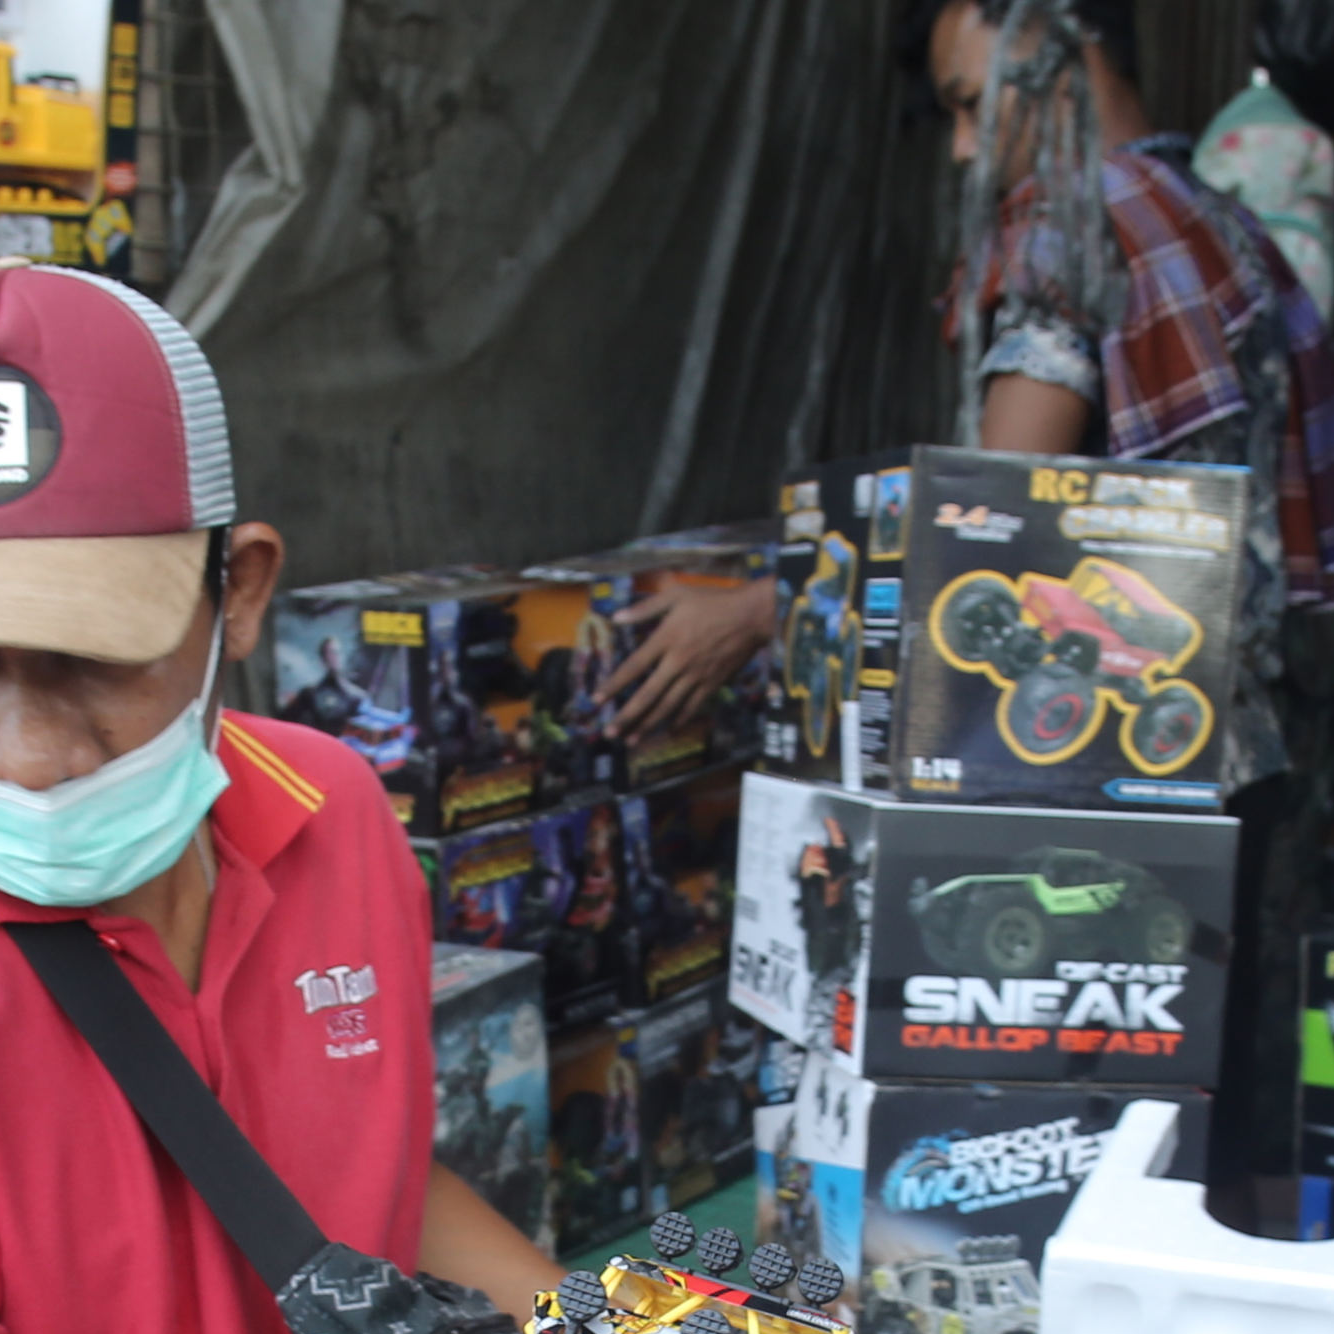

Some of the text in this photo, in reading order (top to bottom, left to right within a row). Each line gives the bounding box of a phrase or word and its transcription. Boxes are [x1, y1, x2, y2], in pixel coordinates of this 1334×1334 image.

[1029, 467, 1090, 503] RC
[903, 974, 1185, 1032] SNEAK
[901, 1024, 1184, 1056] GALLOP BEAST
[949, 1116, 1081, 1167] BIGFOOT
